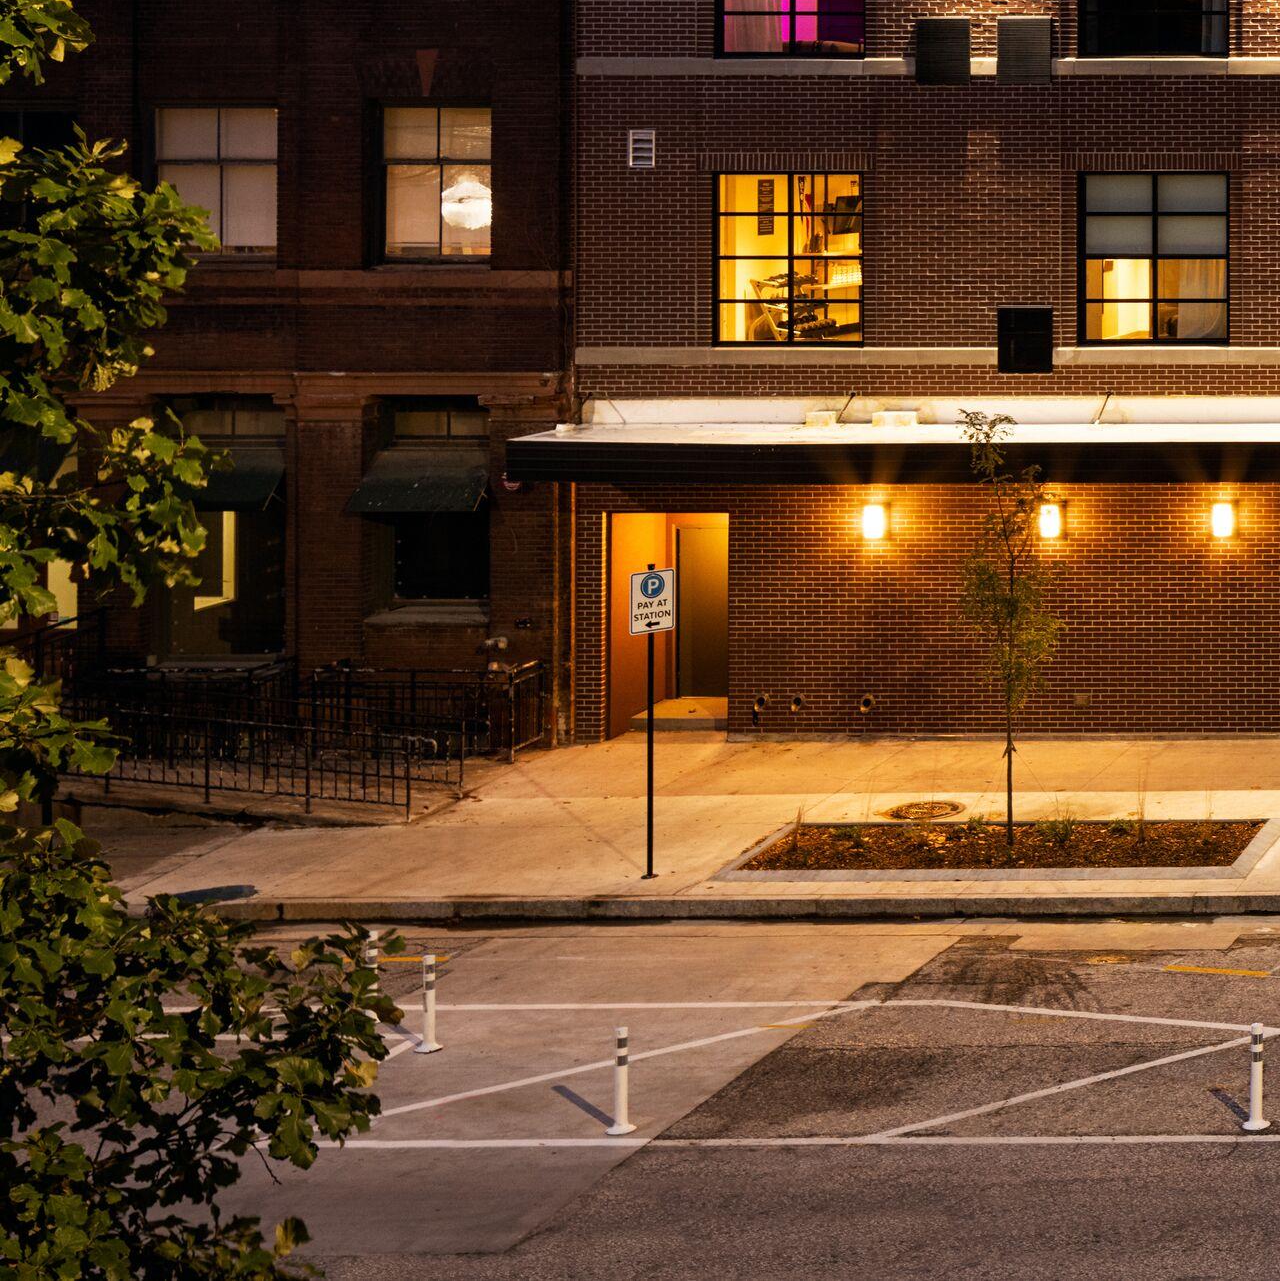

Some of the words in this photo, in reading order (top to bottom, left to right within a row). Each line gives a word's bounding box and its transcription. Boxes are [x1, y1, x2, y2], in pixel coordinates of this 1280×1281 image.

[648, 578, 660, 596] P
[637, 601, 654, 610] PAY
[657, 599, 668, 607] AT
[633, 609, 671, 622] STATION
